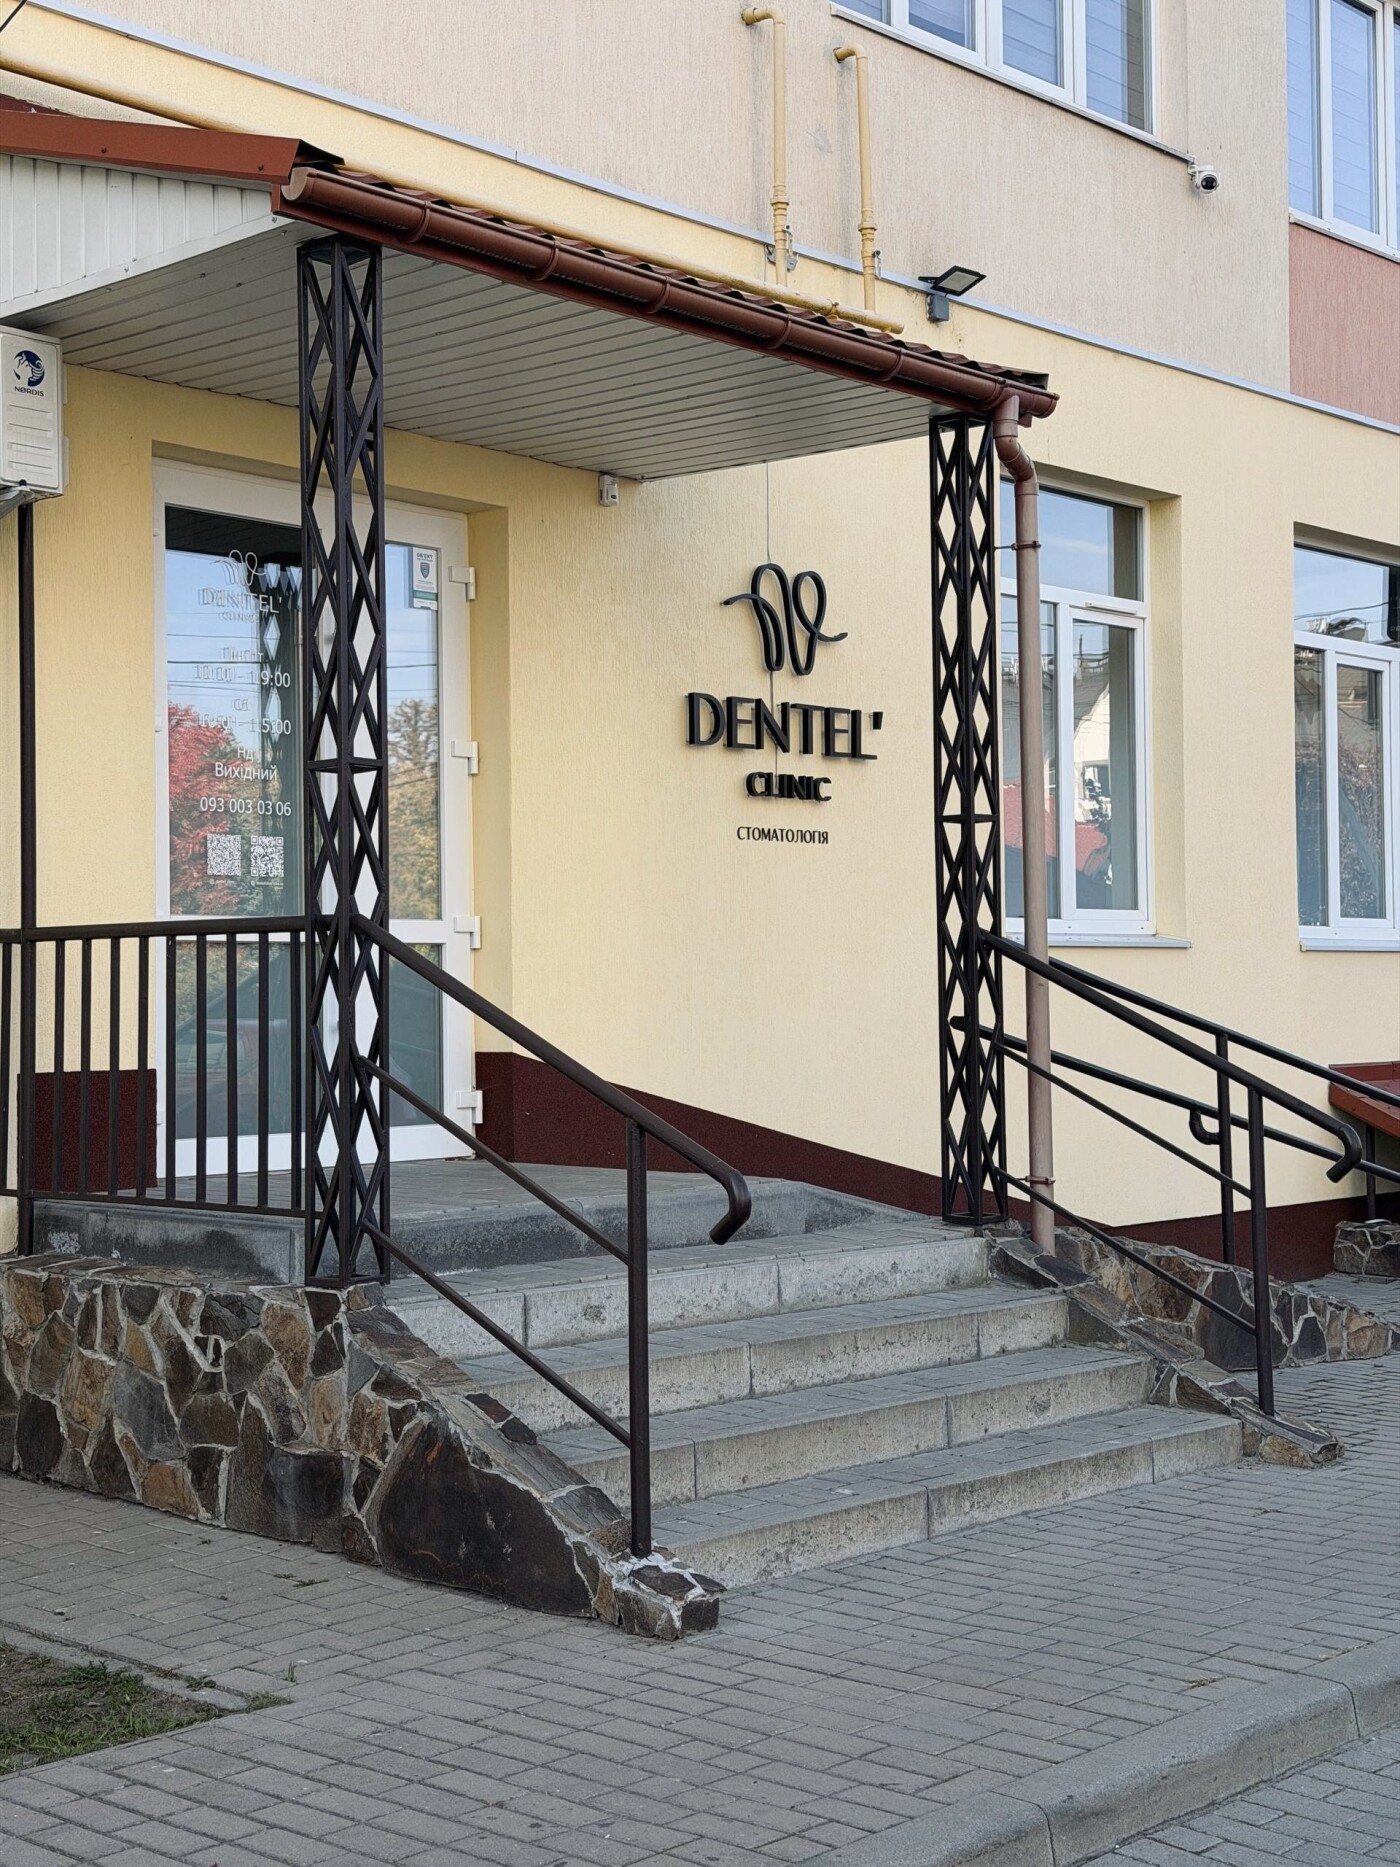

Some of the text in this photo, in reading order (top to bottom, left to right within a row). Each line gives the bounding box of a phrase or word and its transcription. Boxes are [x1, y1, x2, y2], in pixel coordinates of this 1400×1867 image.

[687, 691, 883, 760] DENTEL'
[237, 747, 254, 761] Нд
[215, 761, 278, 782] Вихідний
[745, 771, 832, 802] CLINIC
[200, 796, 292, 817] 093 003 03 06
[736, 826, 829, 844] СТОМАТОЛОГІЯ
